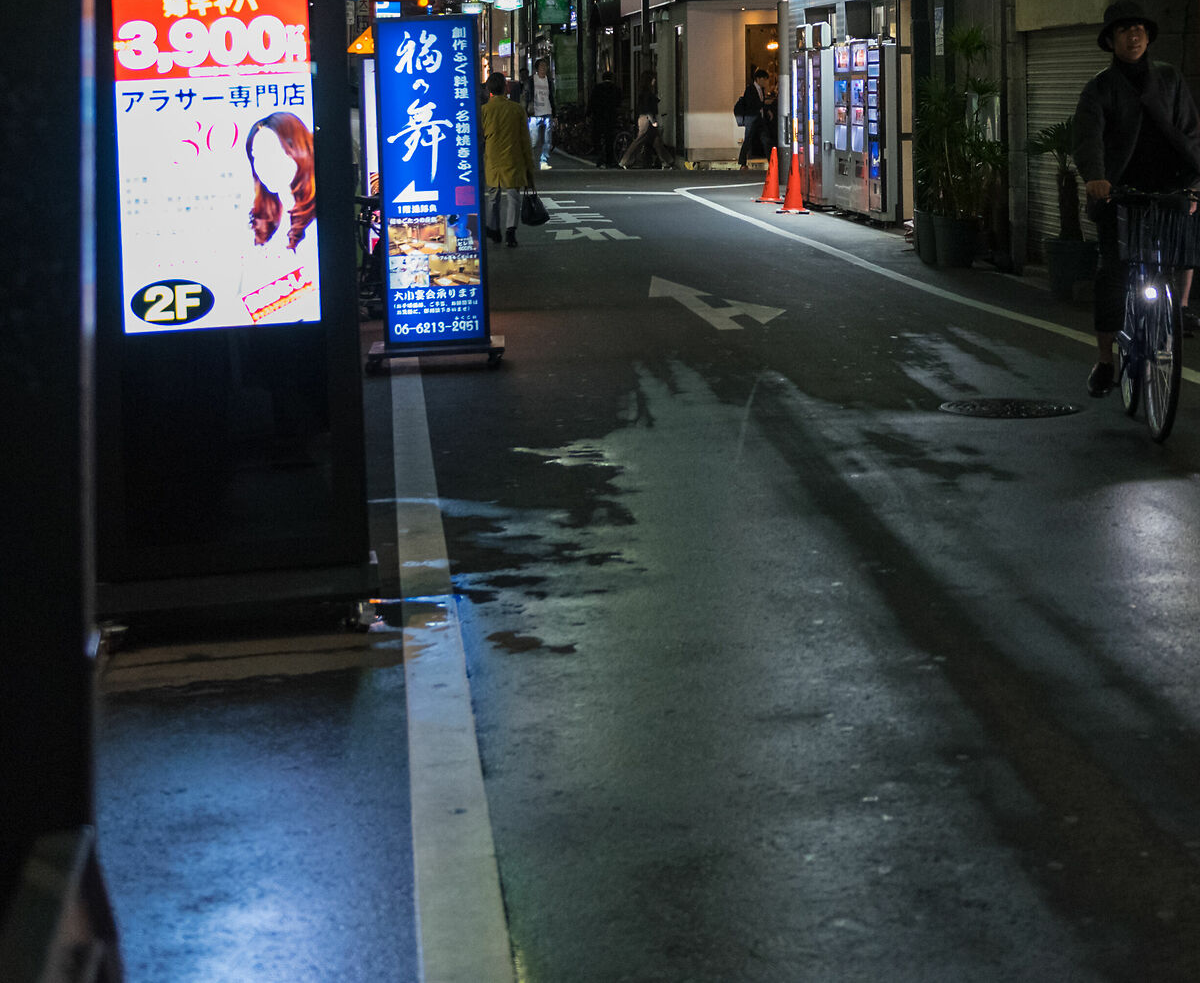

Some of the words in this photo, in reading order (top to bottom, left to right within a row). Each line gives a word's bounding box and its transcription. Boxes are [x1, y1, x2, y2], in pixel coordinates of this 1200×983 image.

[121, 83, 306, 112] アラサー専門店
[387, 30, 453, 183] 福の舞
[143, 284, 202, 322] 2F
[394, 288, 479, 301] 大小宴会承ります
[394, 320, 479, 335] 06-6213-2951
